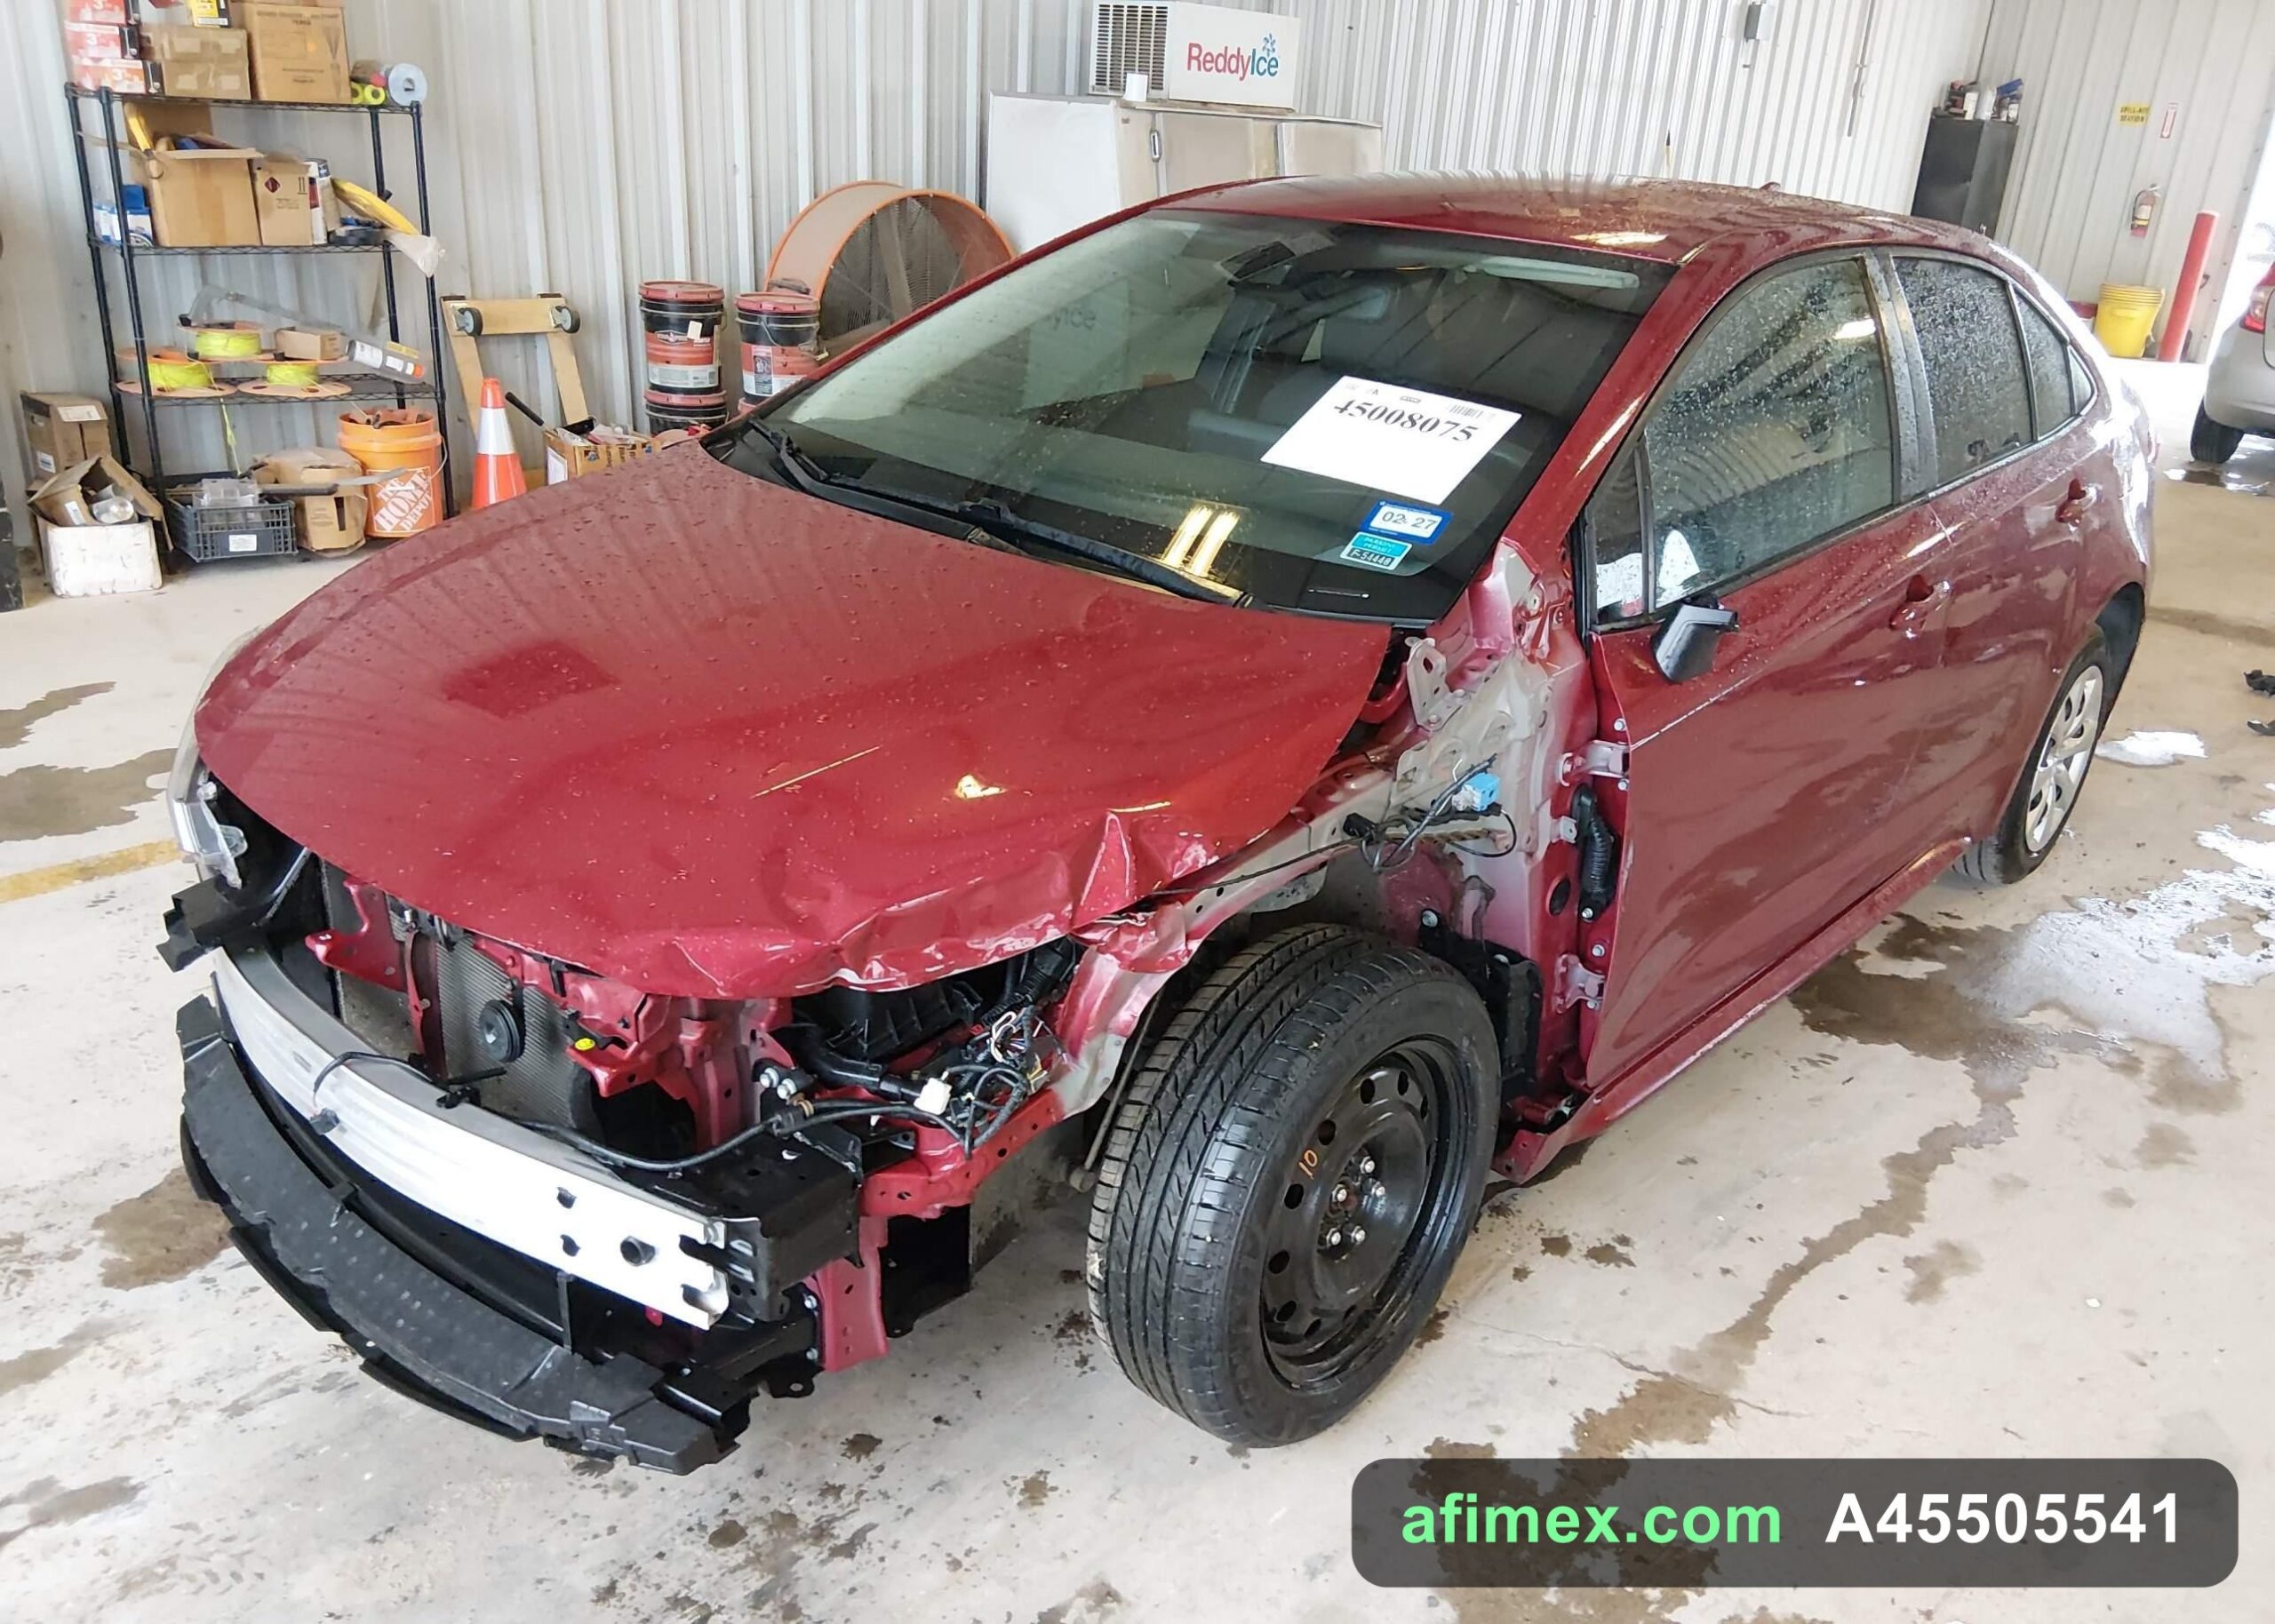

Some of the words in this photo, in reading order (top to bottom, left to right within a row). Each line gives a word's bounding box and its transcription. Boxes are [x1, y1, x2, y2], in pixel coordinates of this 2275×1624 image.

[1333, 399, 1479, 442] 45008075
[374, 469, 428, 532] HOME
[399, 489, 431, 531] DEPOT
[1411, 517, 1438, 530] 27
